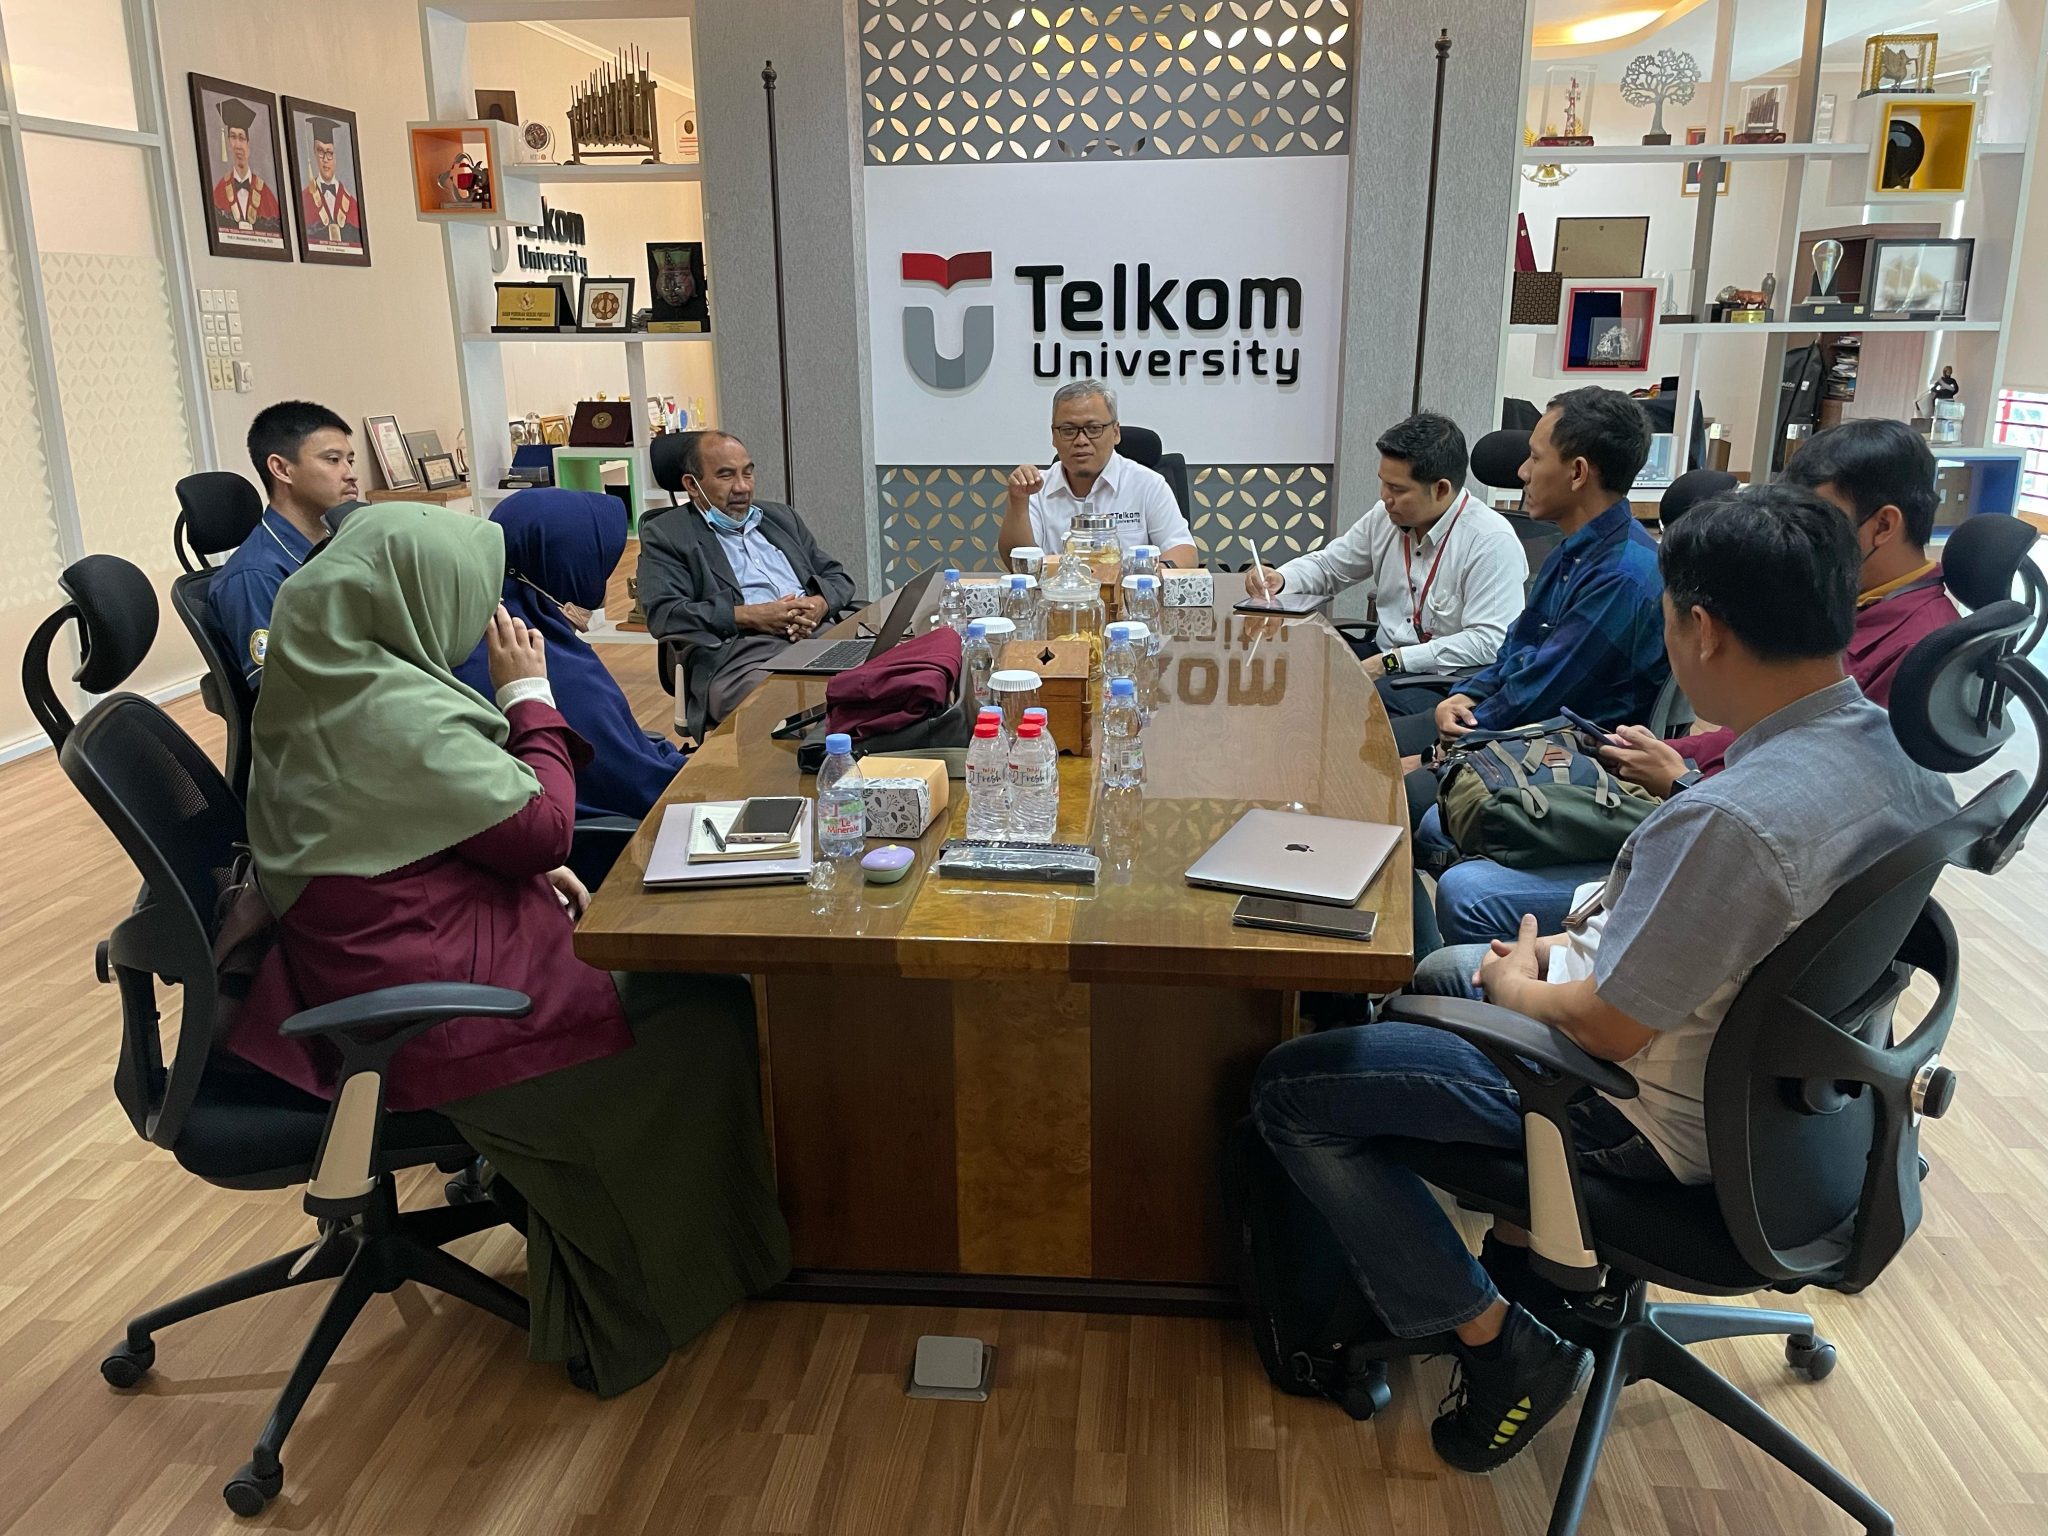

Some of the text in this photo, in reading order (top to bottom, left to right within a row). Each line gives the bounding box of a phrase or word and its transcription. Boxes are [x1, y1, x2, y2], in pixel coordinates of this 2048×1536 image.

[515, 196, 585, 246] kom
[517, 244, 588, 279] University
[1014, 262, 1302, 333] Telkom
[1033, 339, 1300, 385] University
[1114, 512, 1140, 520] Telkom
[976, 771, 1001, 783] Fresh
[1020, 771, 1044, 784] Fresh
[826, 824, 860, 834] Minerale
[840, 819, 851, 827] Le
